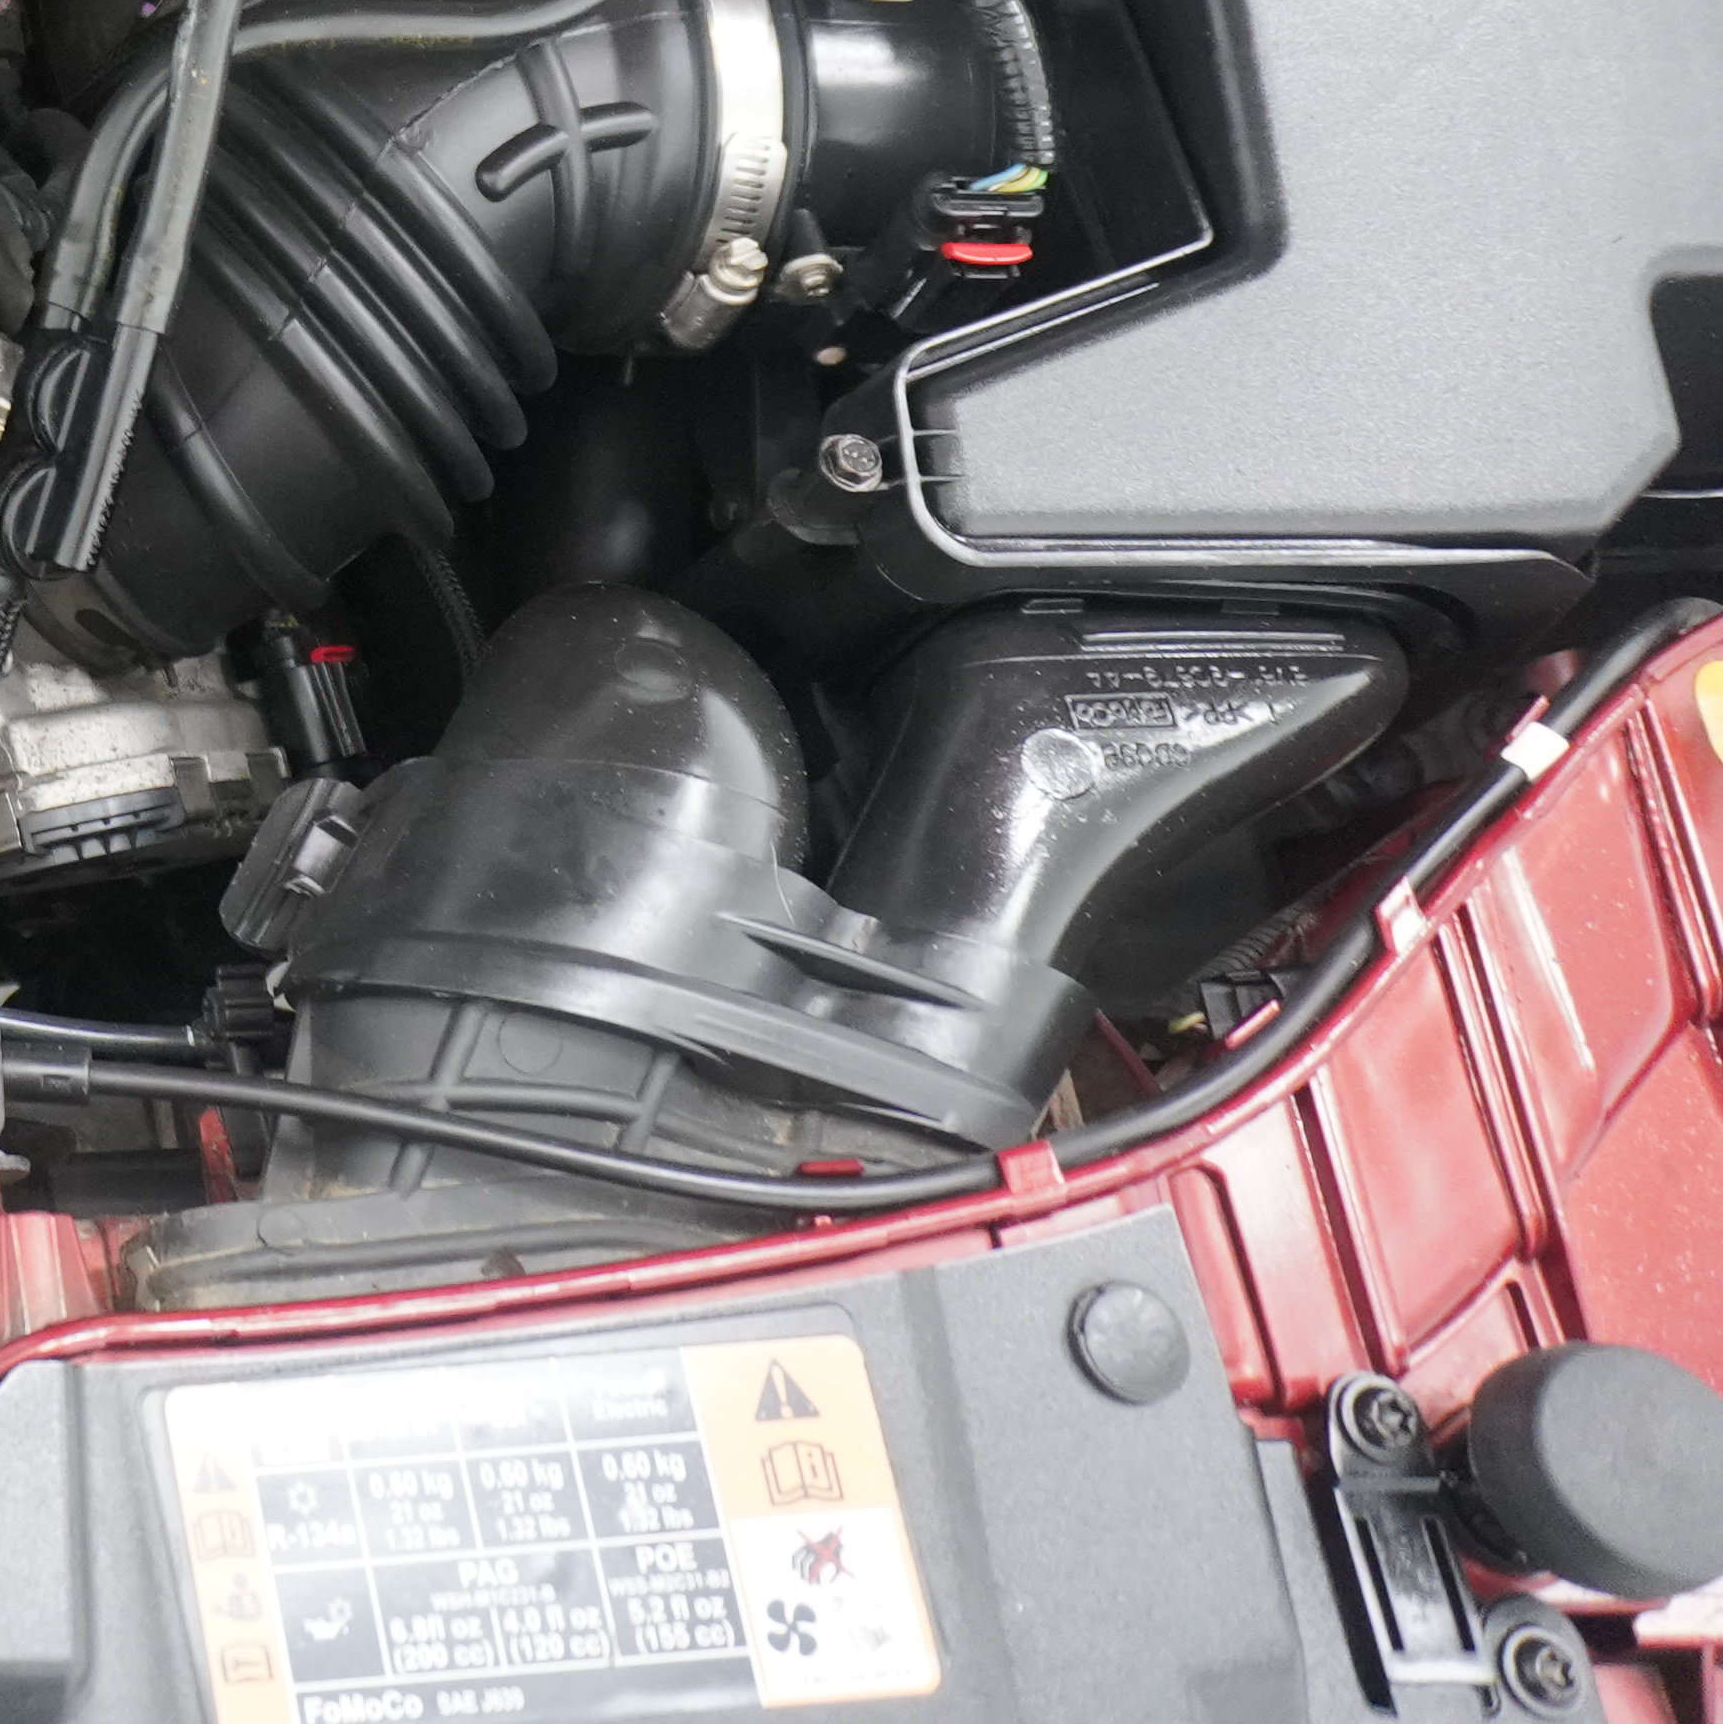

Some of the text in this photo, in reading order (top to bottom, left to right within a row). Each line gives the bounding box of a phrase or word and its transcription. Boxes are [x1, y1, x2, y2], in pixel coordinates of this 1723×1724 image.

[533, 1459, 564, 1491] kg
[655, 1451, 686, 1482] kg
[422, 1471, 454, 1501] kg
[652, 1484, 677, 1503] oz
[420, 1502, 444, 1521] oz
[529, 1492, 554, 1512] oz
[541, 1514, 571, 1538] lbs
[662, 1507, 694, 1529] lbs
[266, 1522, 353, 1552] R-134a
[430, 1523, 460, 1547] lbs
[635, 1543, 698, 1572] POE
[458, 1559, 520, 1587] PAG
[502, 1605, 601, 1633] 4.0 fl oz
[671, 1594, 690, 1618] fl
[694, 1597, 726, 1619] oz
[451, 1616, 483, 1639] oz
[694, 1620, 735, 1648] cc)
[453, 1638, 495, 1667] cc)
[570, 1631, 610, 1661] cc)
[303, 1690, 423, 1724] FoMoCo
[436, 1692, 478, 1716] SAE
